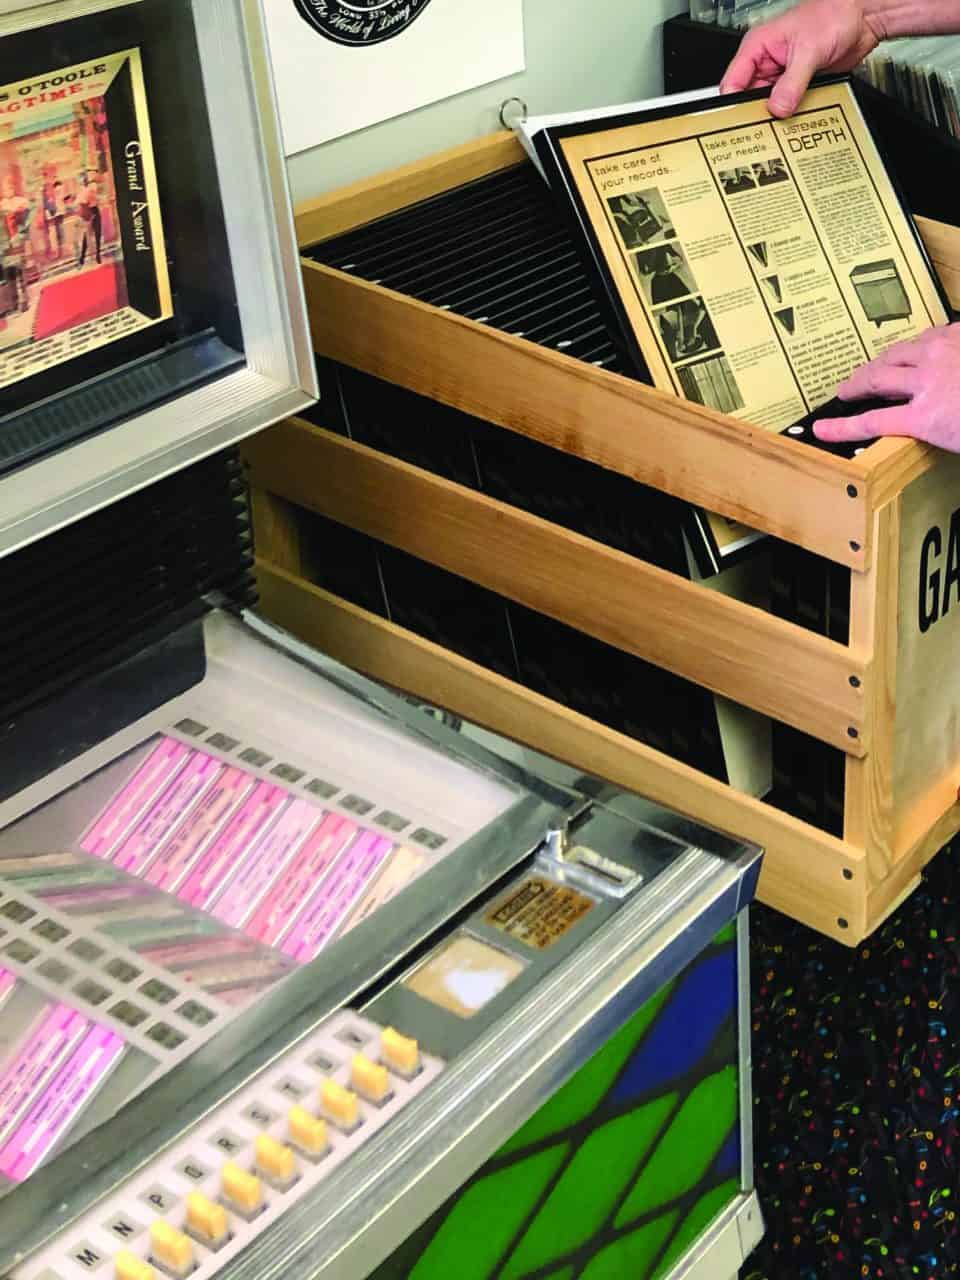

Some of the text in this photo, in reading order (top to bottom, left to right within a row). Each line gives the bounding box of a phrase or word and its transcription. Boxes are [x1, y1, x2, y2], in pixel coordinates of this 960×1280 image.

[782, 118, 829, 136] LISTENING
[704, 129, 764, 151] take care of
[787, 127, 847, 153] DEPTH
[594, 153, 660, 176] take care of
[711, 151, 732, 165] your
[601, 177, 625, 191] your
[124, 140, 151, 251] Grand Award
[76, 1248, 101, 1267] M
[112, 1220, 134, 1238] N
[149, 1193, 165, 1209] P
